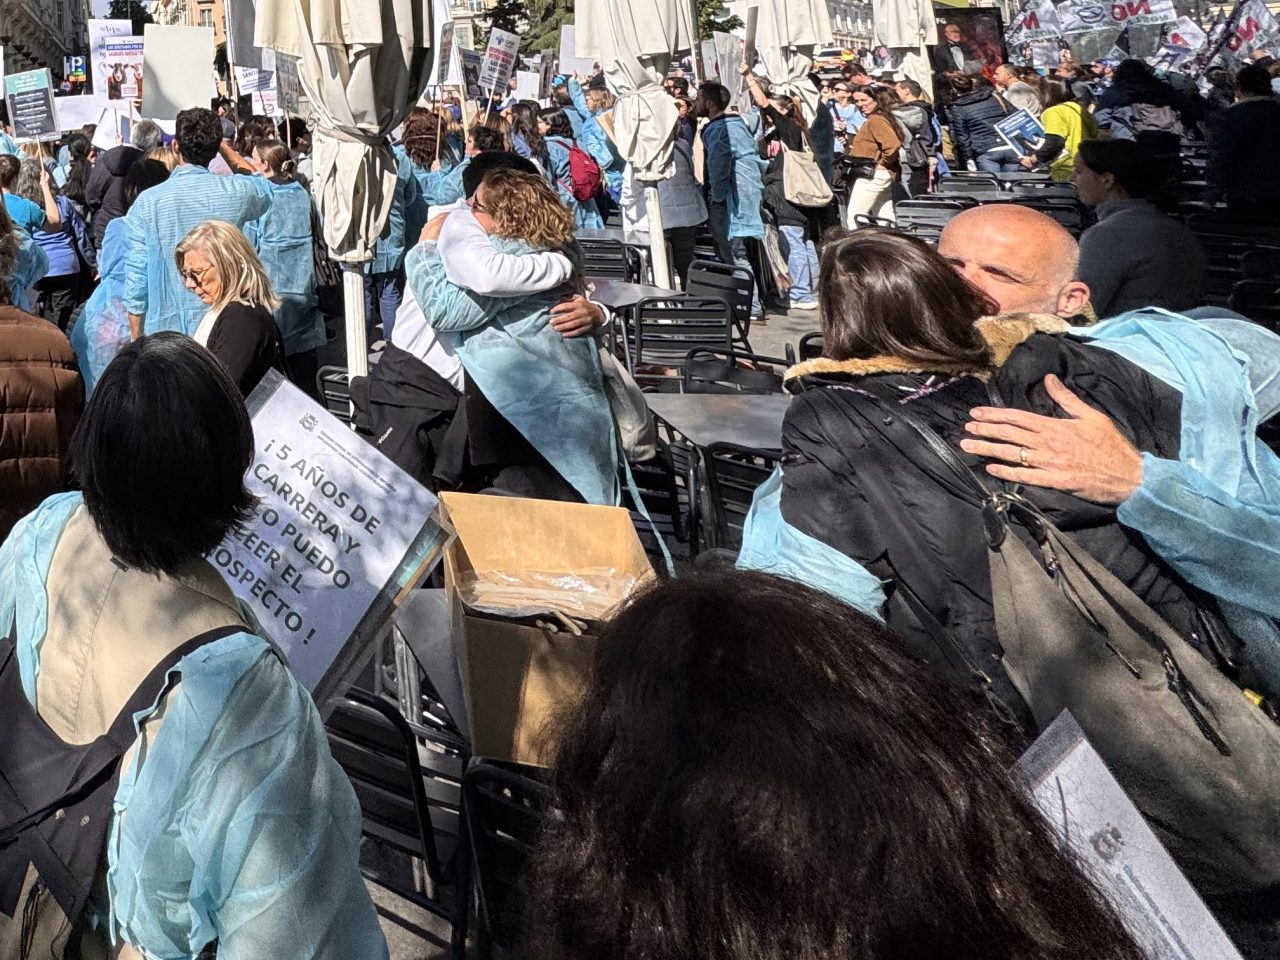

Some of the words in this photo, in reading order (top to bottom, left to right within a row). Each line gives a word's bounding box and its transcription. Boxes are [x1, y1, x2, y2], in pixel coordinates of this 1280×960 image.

[71, 56, 83, 72] P
[253, 463, 341, 544] CARRERA
[344, 535, 362, 555] Y
[290, 458, 350, 509] AÑOS
[349, 503, 381, 536] DE
[280, 522, 351, 590] PUEDO
[280, 563, 303, 594] EL
